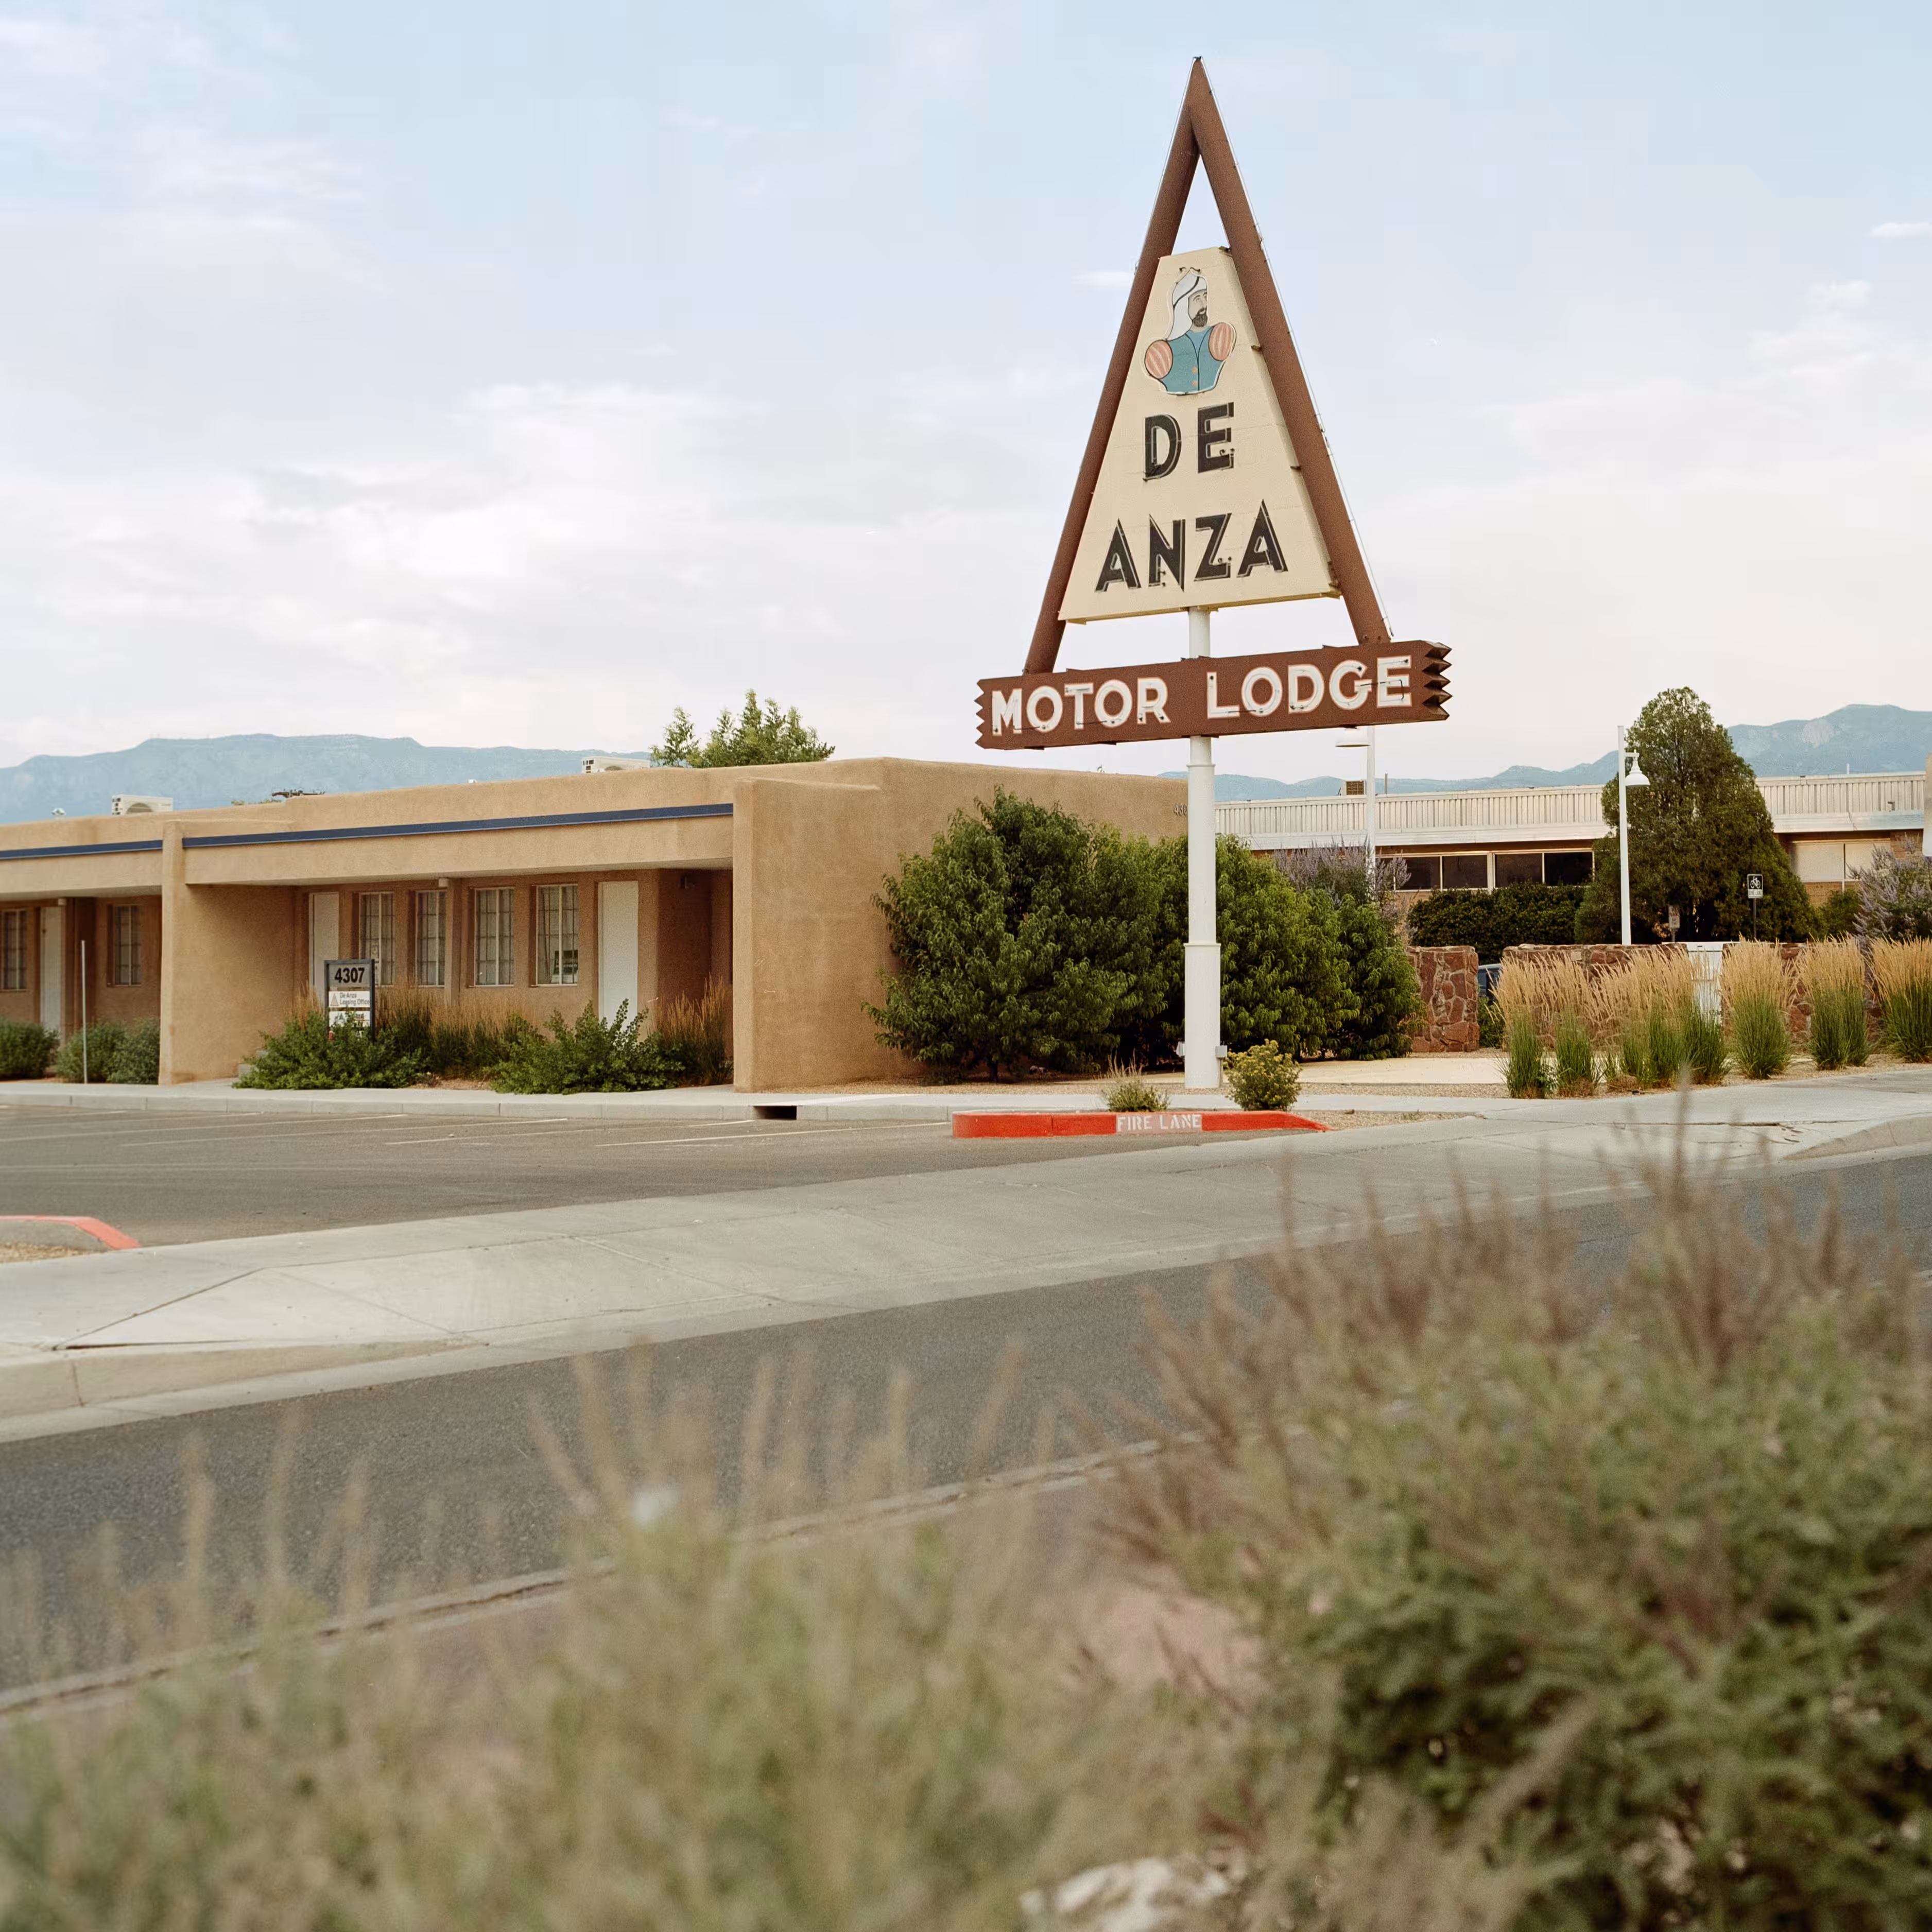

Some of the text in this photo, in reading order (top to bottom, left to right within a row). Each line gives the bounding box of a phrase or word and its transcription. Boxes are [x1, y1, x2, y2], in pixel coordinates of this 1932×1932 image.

[1143, 402, 1235, 481] DE
[1095, 499, 1288, 593] ANZA
[991, 655, 1412, 737] MOTOR LODGE
[335, 967, 365, 983] 4307
[1117, 1114, 1201, 1132] FIRE LANE
